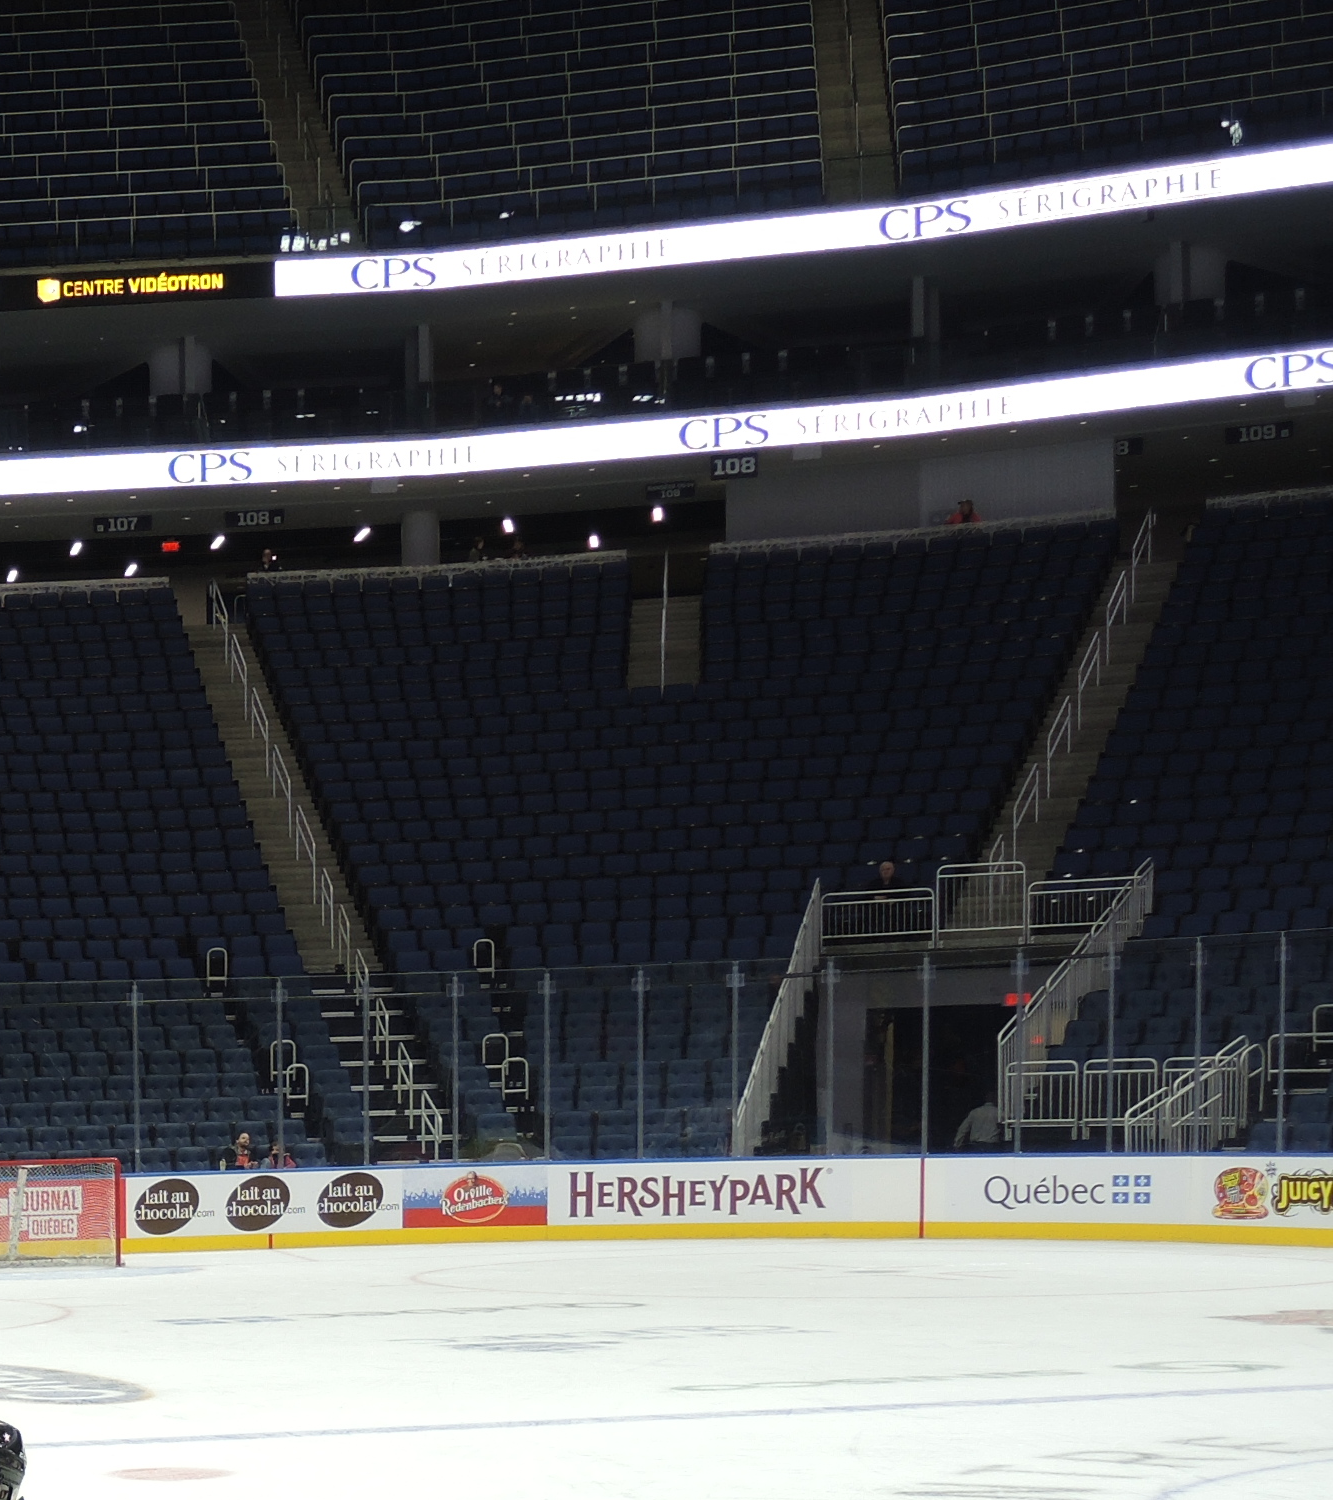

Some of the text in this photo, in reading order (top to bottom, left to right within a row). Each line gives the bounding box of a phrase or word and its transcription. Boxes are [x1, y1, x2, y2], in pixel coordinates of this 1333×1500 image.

[878, 165, 1224, 242] CPS SÉRIGRAPHIE
[351, 256, 436, 290] CPS
[63, 272, 224, 297] CENTRE VIDÉOTRON
[1244, 350, 1333, 391] CPS
[678, 413, 770, 452] CPS
[1238, 424, 1276, 442] 109
[167, 451, 254, 484] CPS
[714, 457, 756, 476] 108
[107, 517, 138, 532] 107
[237, 511, 270, 527] 108
[144, 1189, 189, 1204] lait au
[236, 1186, 280, 1201] lait au
[327, 1183, 373, 1198] lait au
[453, 1184, 493, 1203] Orville
[568, 1166, 826, 1218] HERSHEYPARK
[984, 1175, 1106, 1210] Québec
[1277, 1178, 1333, 1210] JUICY
[32, 1217, 74, 1236] QUÉBEC
